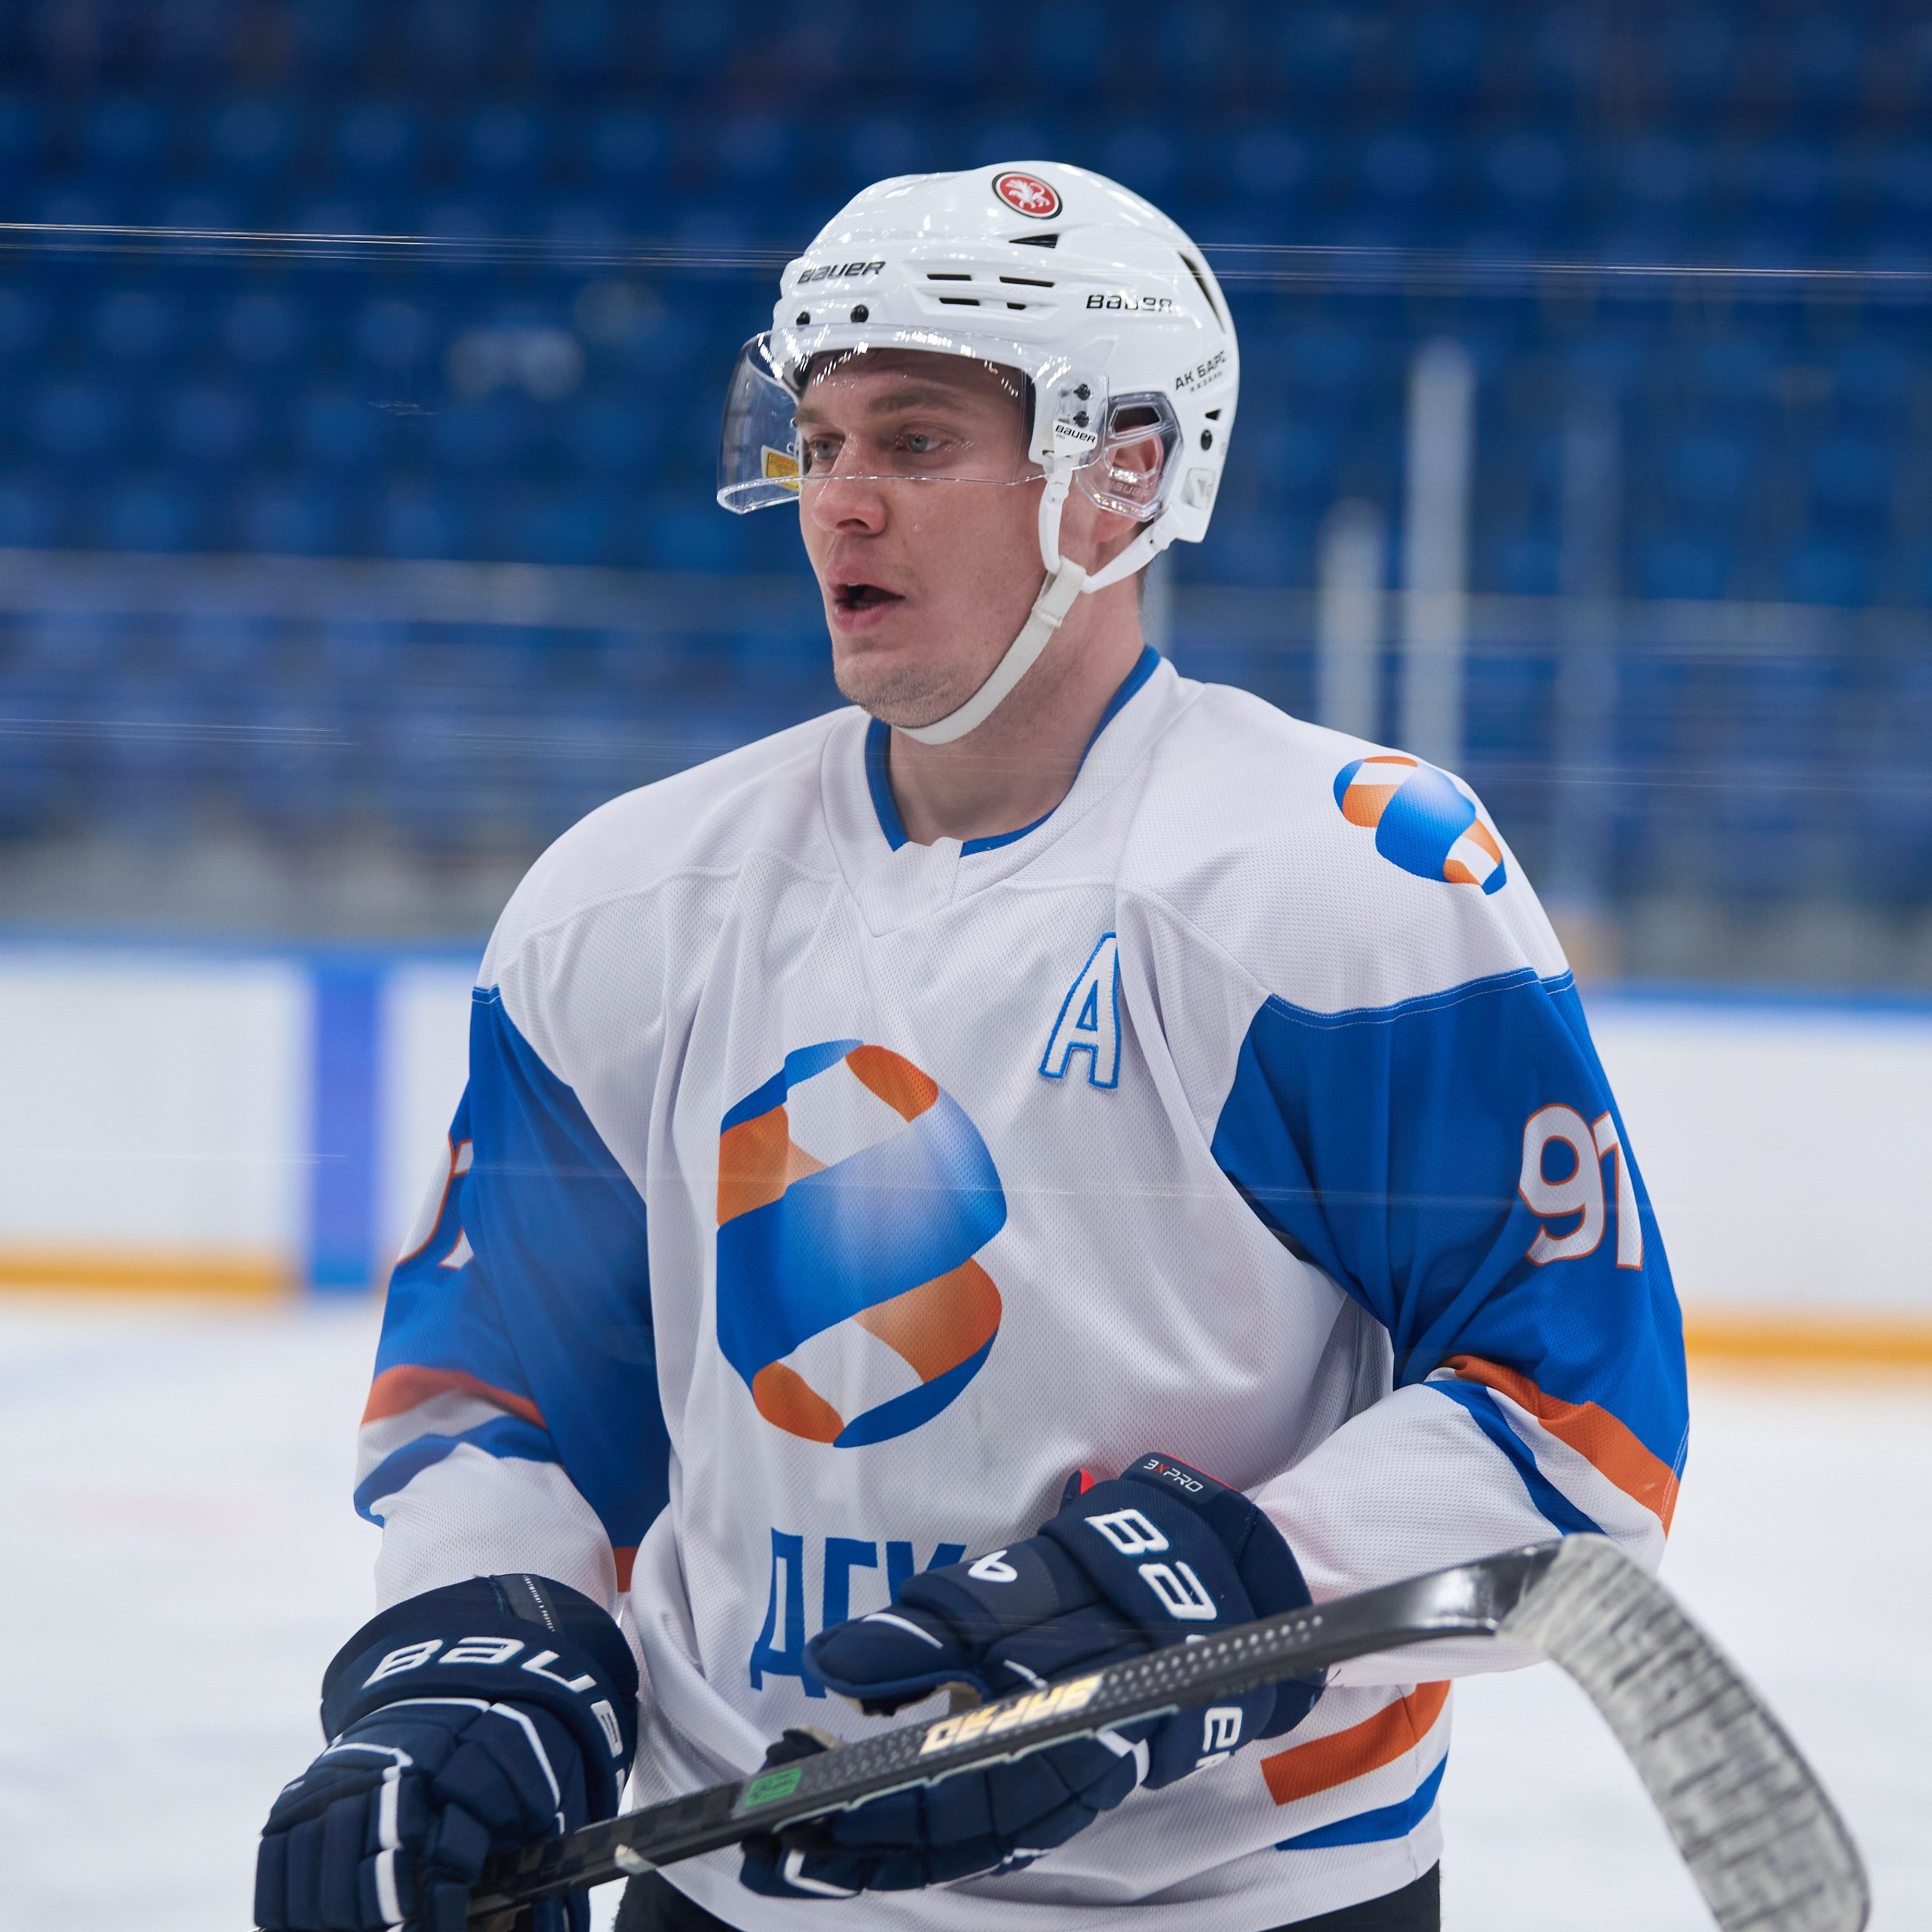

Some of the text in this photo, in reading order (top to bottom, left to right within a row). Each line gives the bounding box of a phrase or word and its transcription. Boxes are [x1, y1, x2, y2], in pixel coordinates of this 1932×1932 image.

[797, 260, 886, 284] BAUER
[1175, 350, 1226, 390] АК БАРС
[1055, 425, 1096, 444] BAUER
[1108, 480, 1149, 498] AUER
[1038, 931, 1121, 1089] A
[1518, 1102, 1643, 1271] 91
[1143, 1459, 1204, 1493] 3XPRO
[361, 1636, 626, 1807] BAUE
